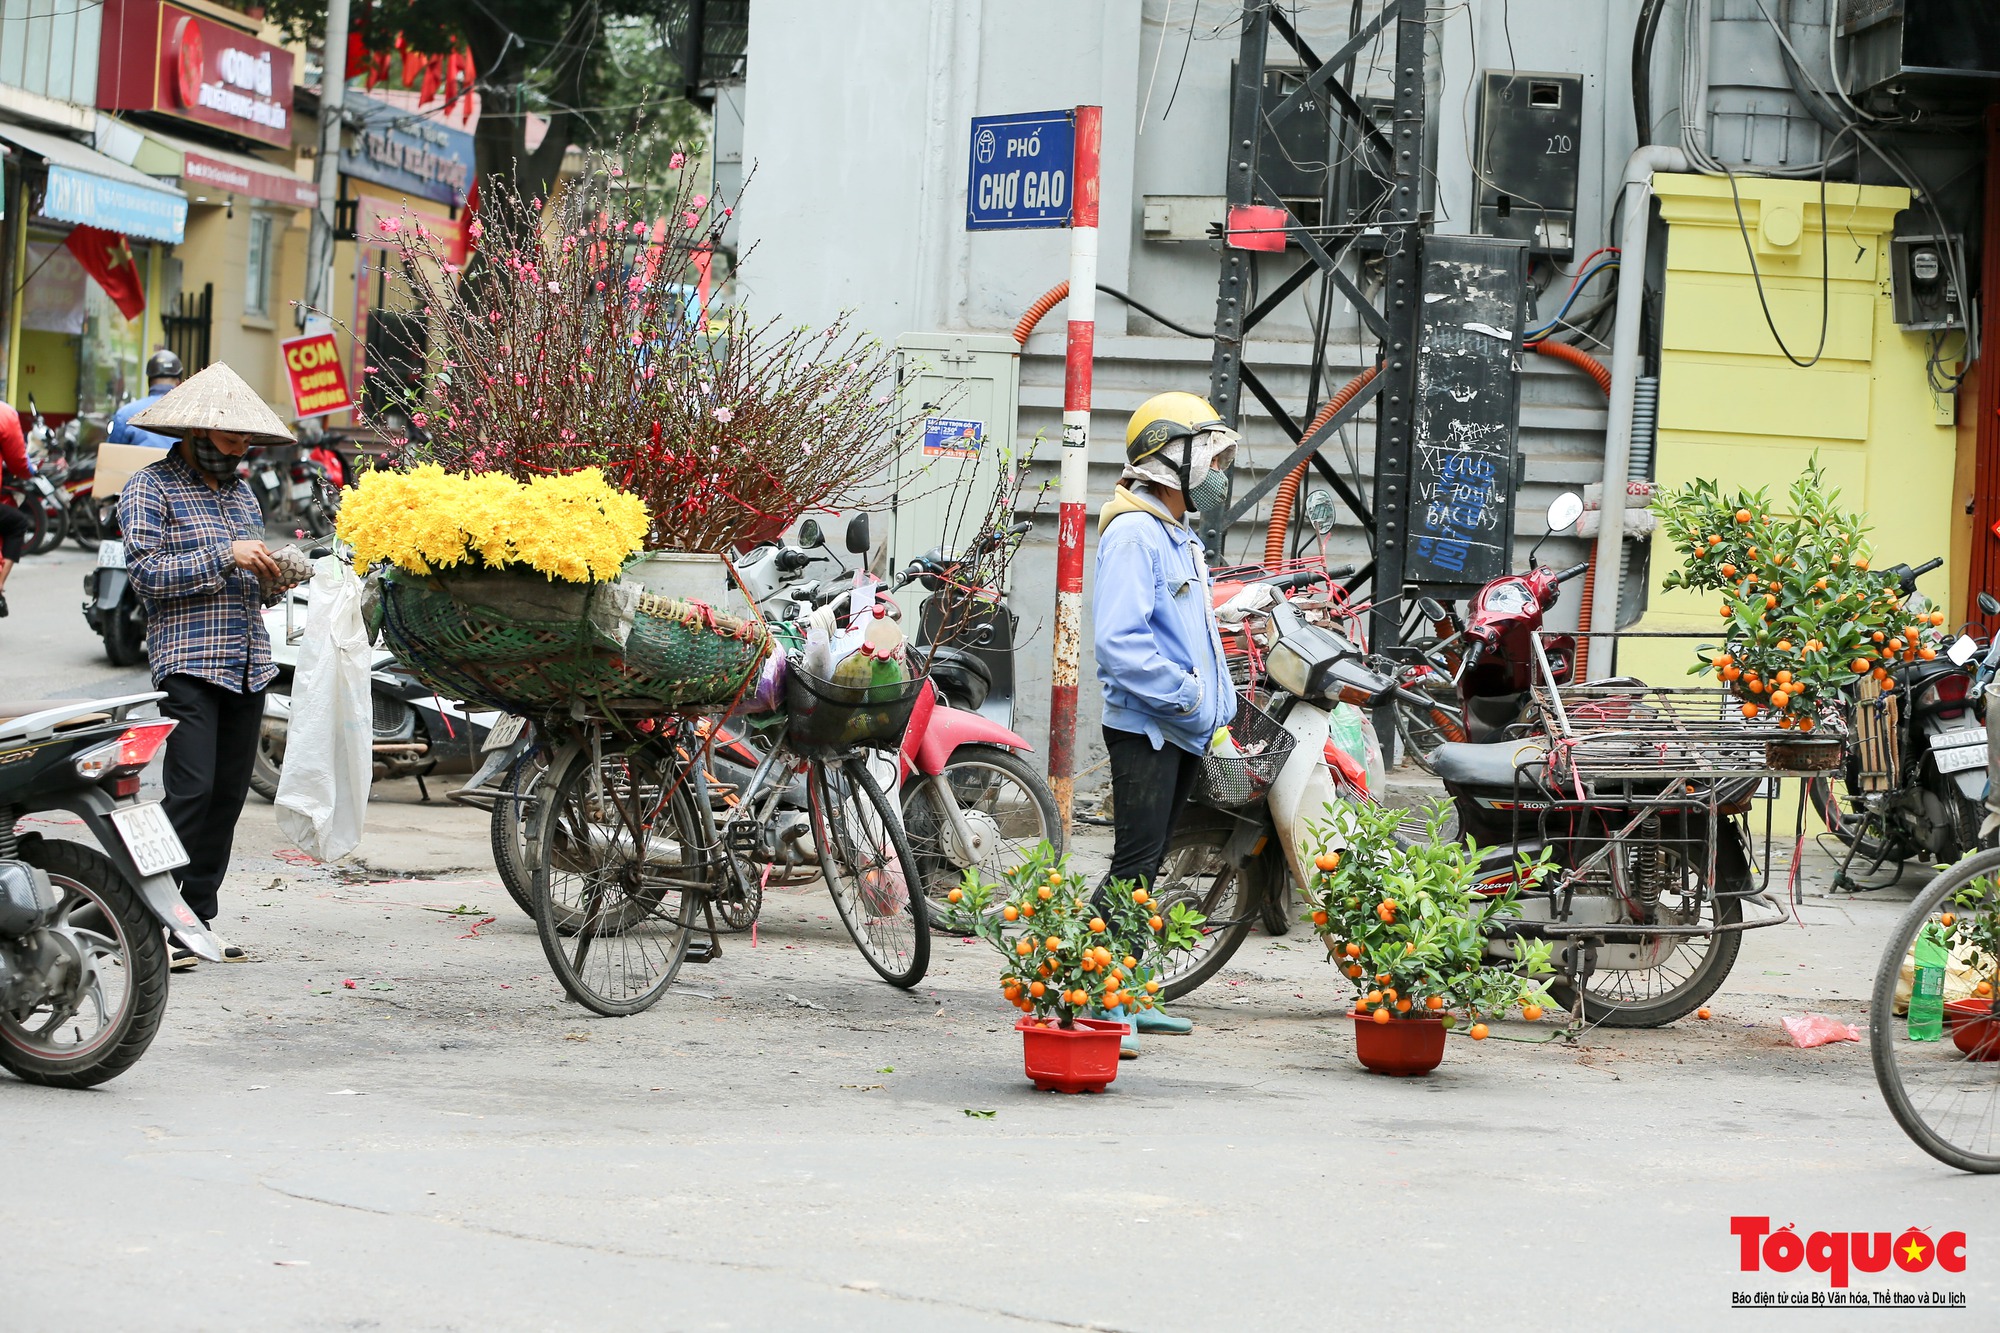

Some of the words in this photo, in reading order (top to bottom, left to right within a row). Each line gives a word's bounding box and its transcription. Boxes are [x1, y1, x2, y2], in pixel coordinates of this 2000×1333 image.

[1006, 127, 1042, 159] PHỐ
[1545, 134, 1572, 155] 220
[979, 169, 1020, 218] CHỢ
[1023, 170, 1065, 217] GẠO
[287, 340, 338, 372] CƠM
[122, 807, 165, 841] 29-C1
[134, 834, 184, 870] 835.01
